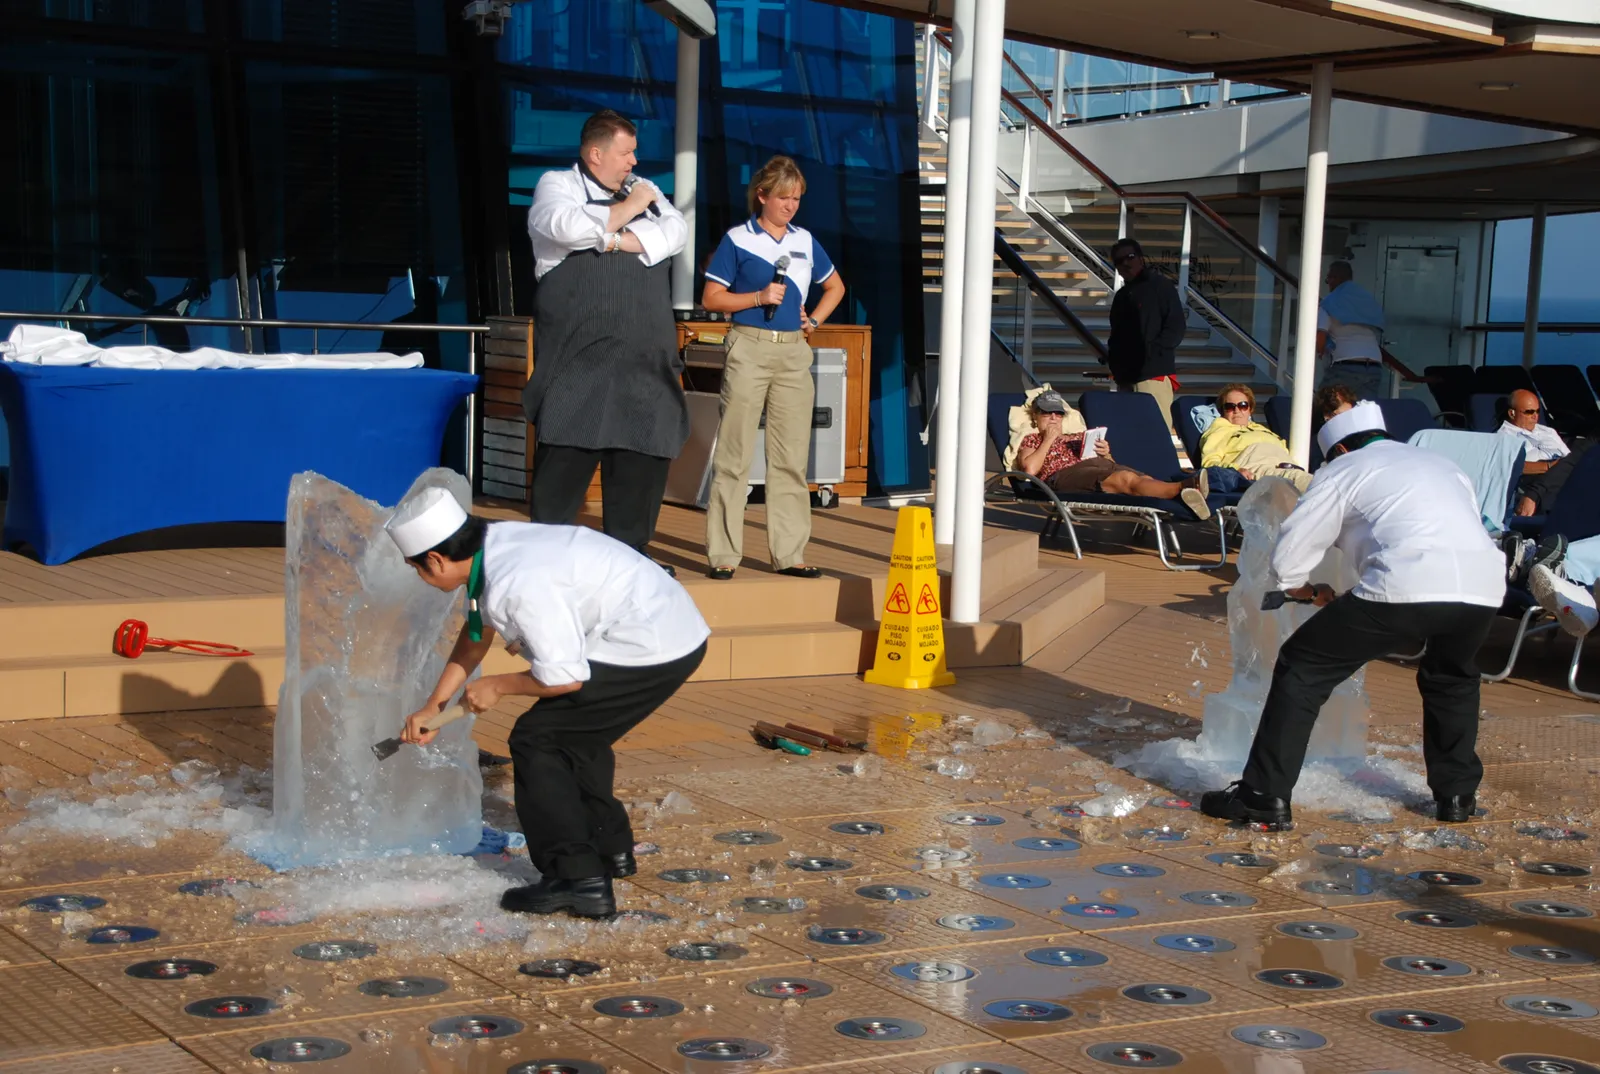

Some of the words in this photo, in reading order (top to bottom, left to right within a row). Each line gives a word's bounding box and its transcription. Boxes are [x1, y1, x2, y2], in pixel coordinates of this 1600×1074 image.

[884, 624, 910, 632] CUIDADO
[916, 624, 940, 632] CUIDADO
[885, 639, 906, 648] MOJADO
